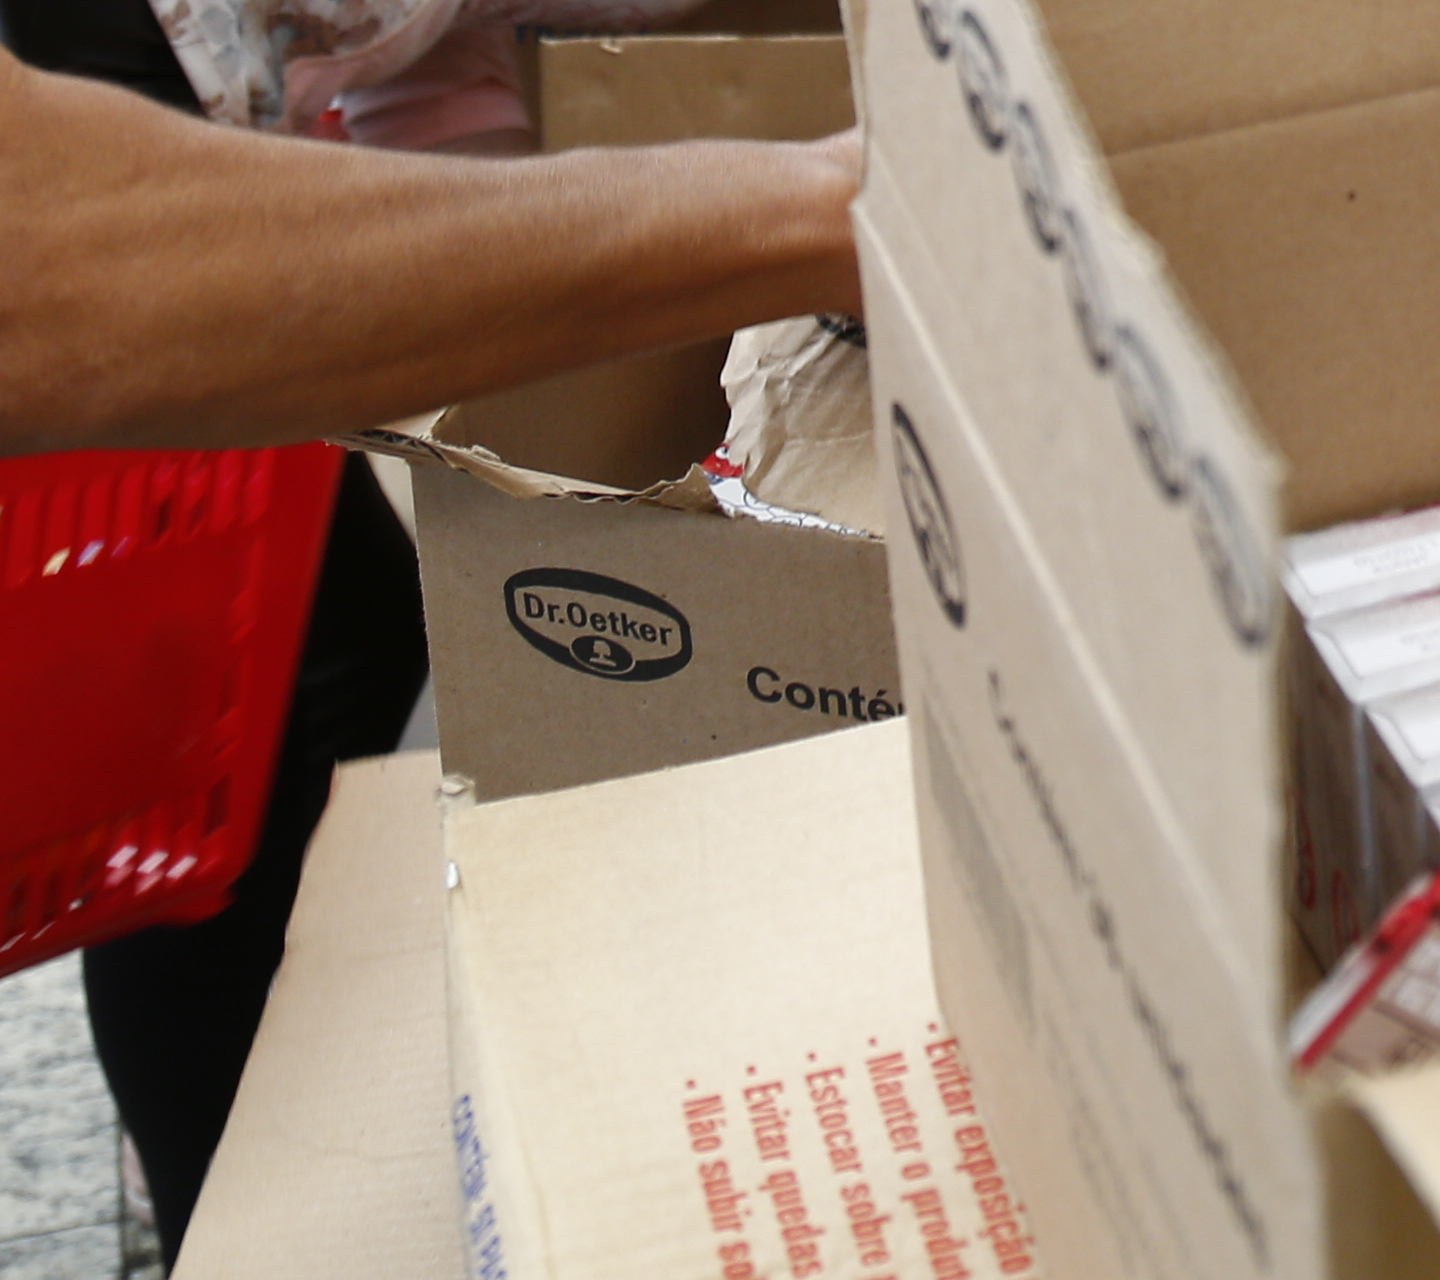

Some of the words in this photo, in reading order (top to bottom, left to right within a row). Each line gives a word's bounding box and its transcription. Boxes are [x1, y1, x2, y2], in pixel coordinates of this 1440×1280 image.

[522, 591, 672, 647] Dr.Oetker
[685, 1093, 726, 1153] Não
[744, 1078, 792, 1165] Evitar
[868, 1051, 923, 1156] Manter
[902, 1161, 930, 1182] o
[926, 1035, 979, 1121] Evitar
[955, 1115, 1033, 1278] exposição
[700, 1154, 750, 1236] subir
[807, 1065, 860, 1177] Estocar
[841, 1180, 888, 1270] sobre
[756, 1169, 824, 1280] quedas
